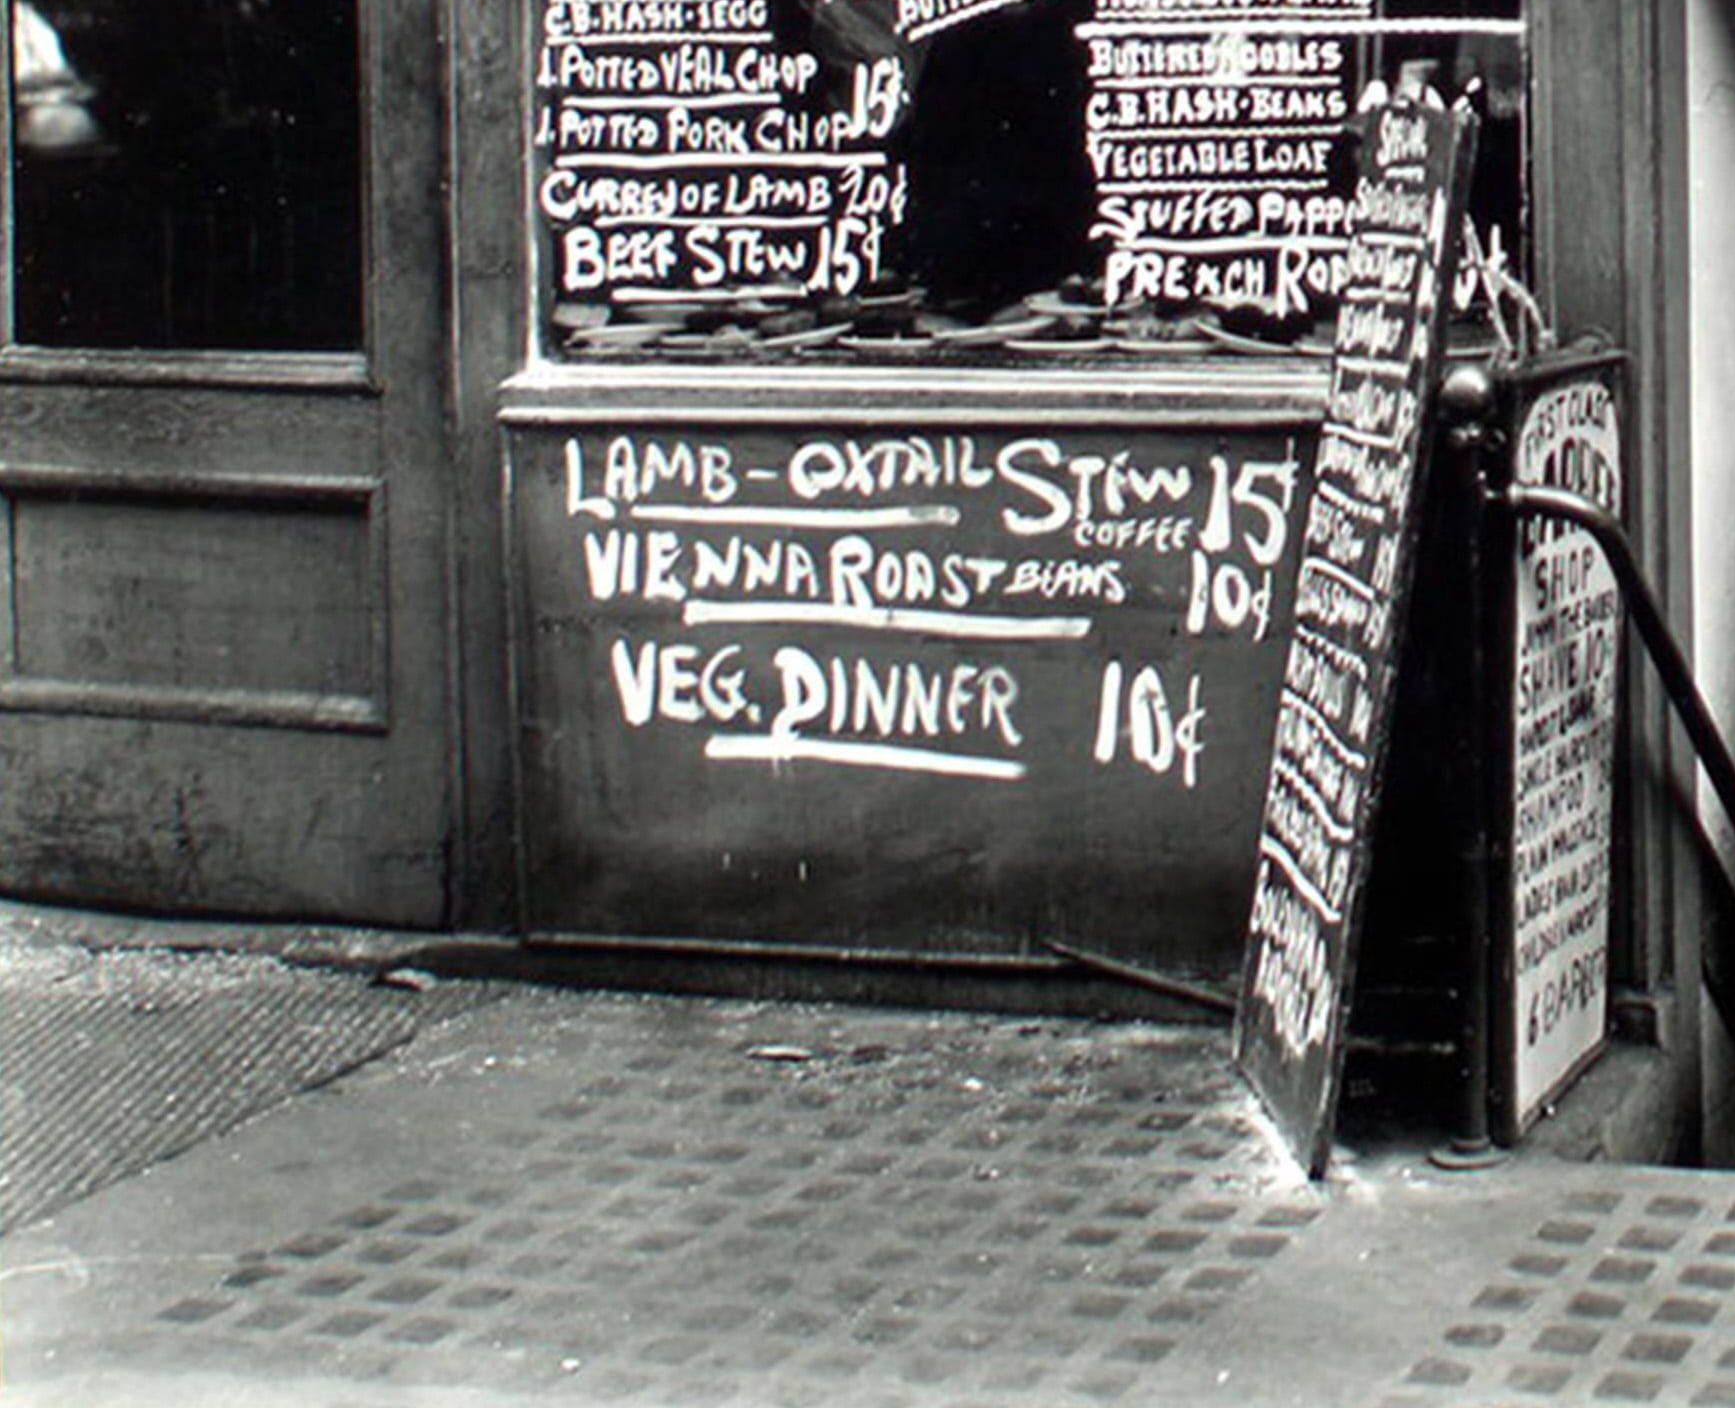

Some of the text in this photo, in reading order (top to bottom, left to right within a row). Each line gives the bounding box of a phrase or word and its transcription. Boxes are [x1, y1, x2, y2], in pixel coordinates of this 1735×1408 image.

[661, 44, 735, 92] VEAL
[735, 49, 817, 93] CHOP
[667, 106, 749, 153] PORK
[755, 108, 850, 153] CHOP
[1086, 137, 1250, 179] VEGETABLE
[1255, 137, 1332, 172] LOAF
[724, 174, 831, 214] LAMB
[564, 226, 676, 291] BEEF
[686, 226, 807, 284] STEW
[998, 438, 1192, 535] STEW
[1201, 438, 1298, 565] 15¢
[1074, 518, 1194, 550] COFFEE
[583, 531, 817, 601] VIENNA
[831, 538, 1006, 611] ROAST
[1535, 546, 1594, 610] SHOP
[612, 640, 759, 726] VEG.
[772, 648, 1021, 746] DINNER
[1094, 661, 1205, 787] 10¢
